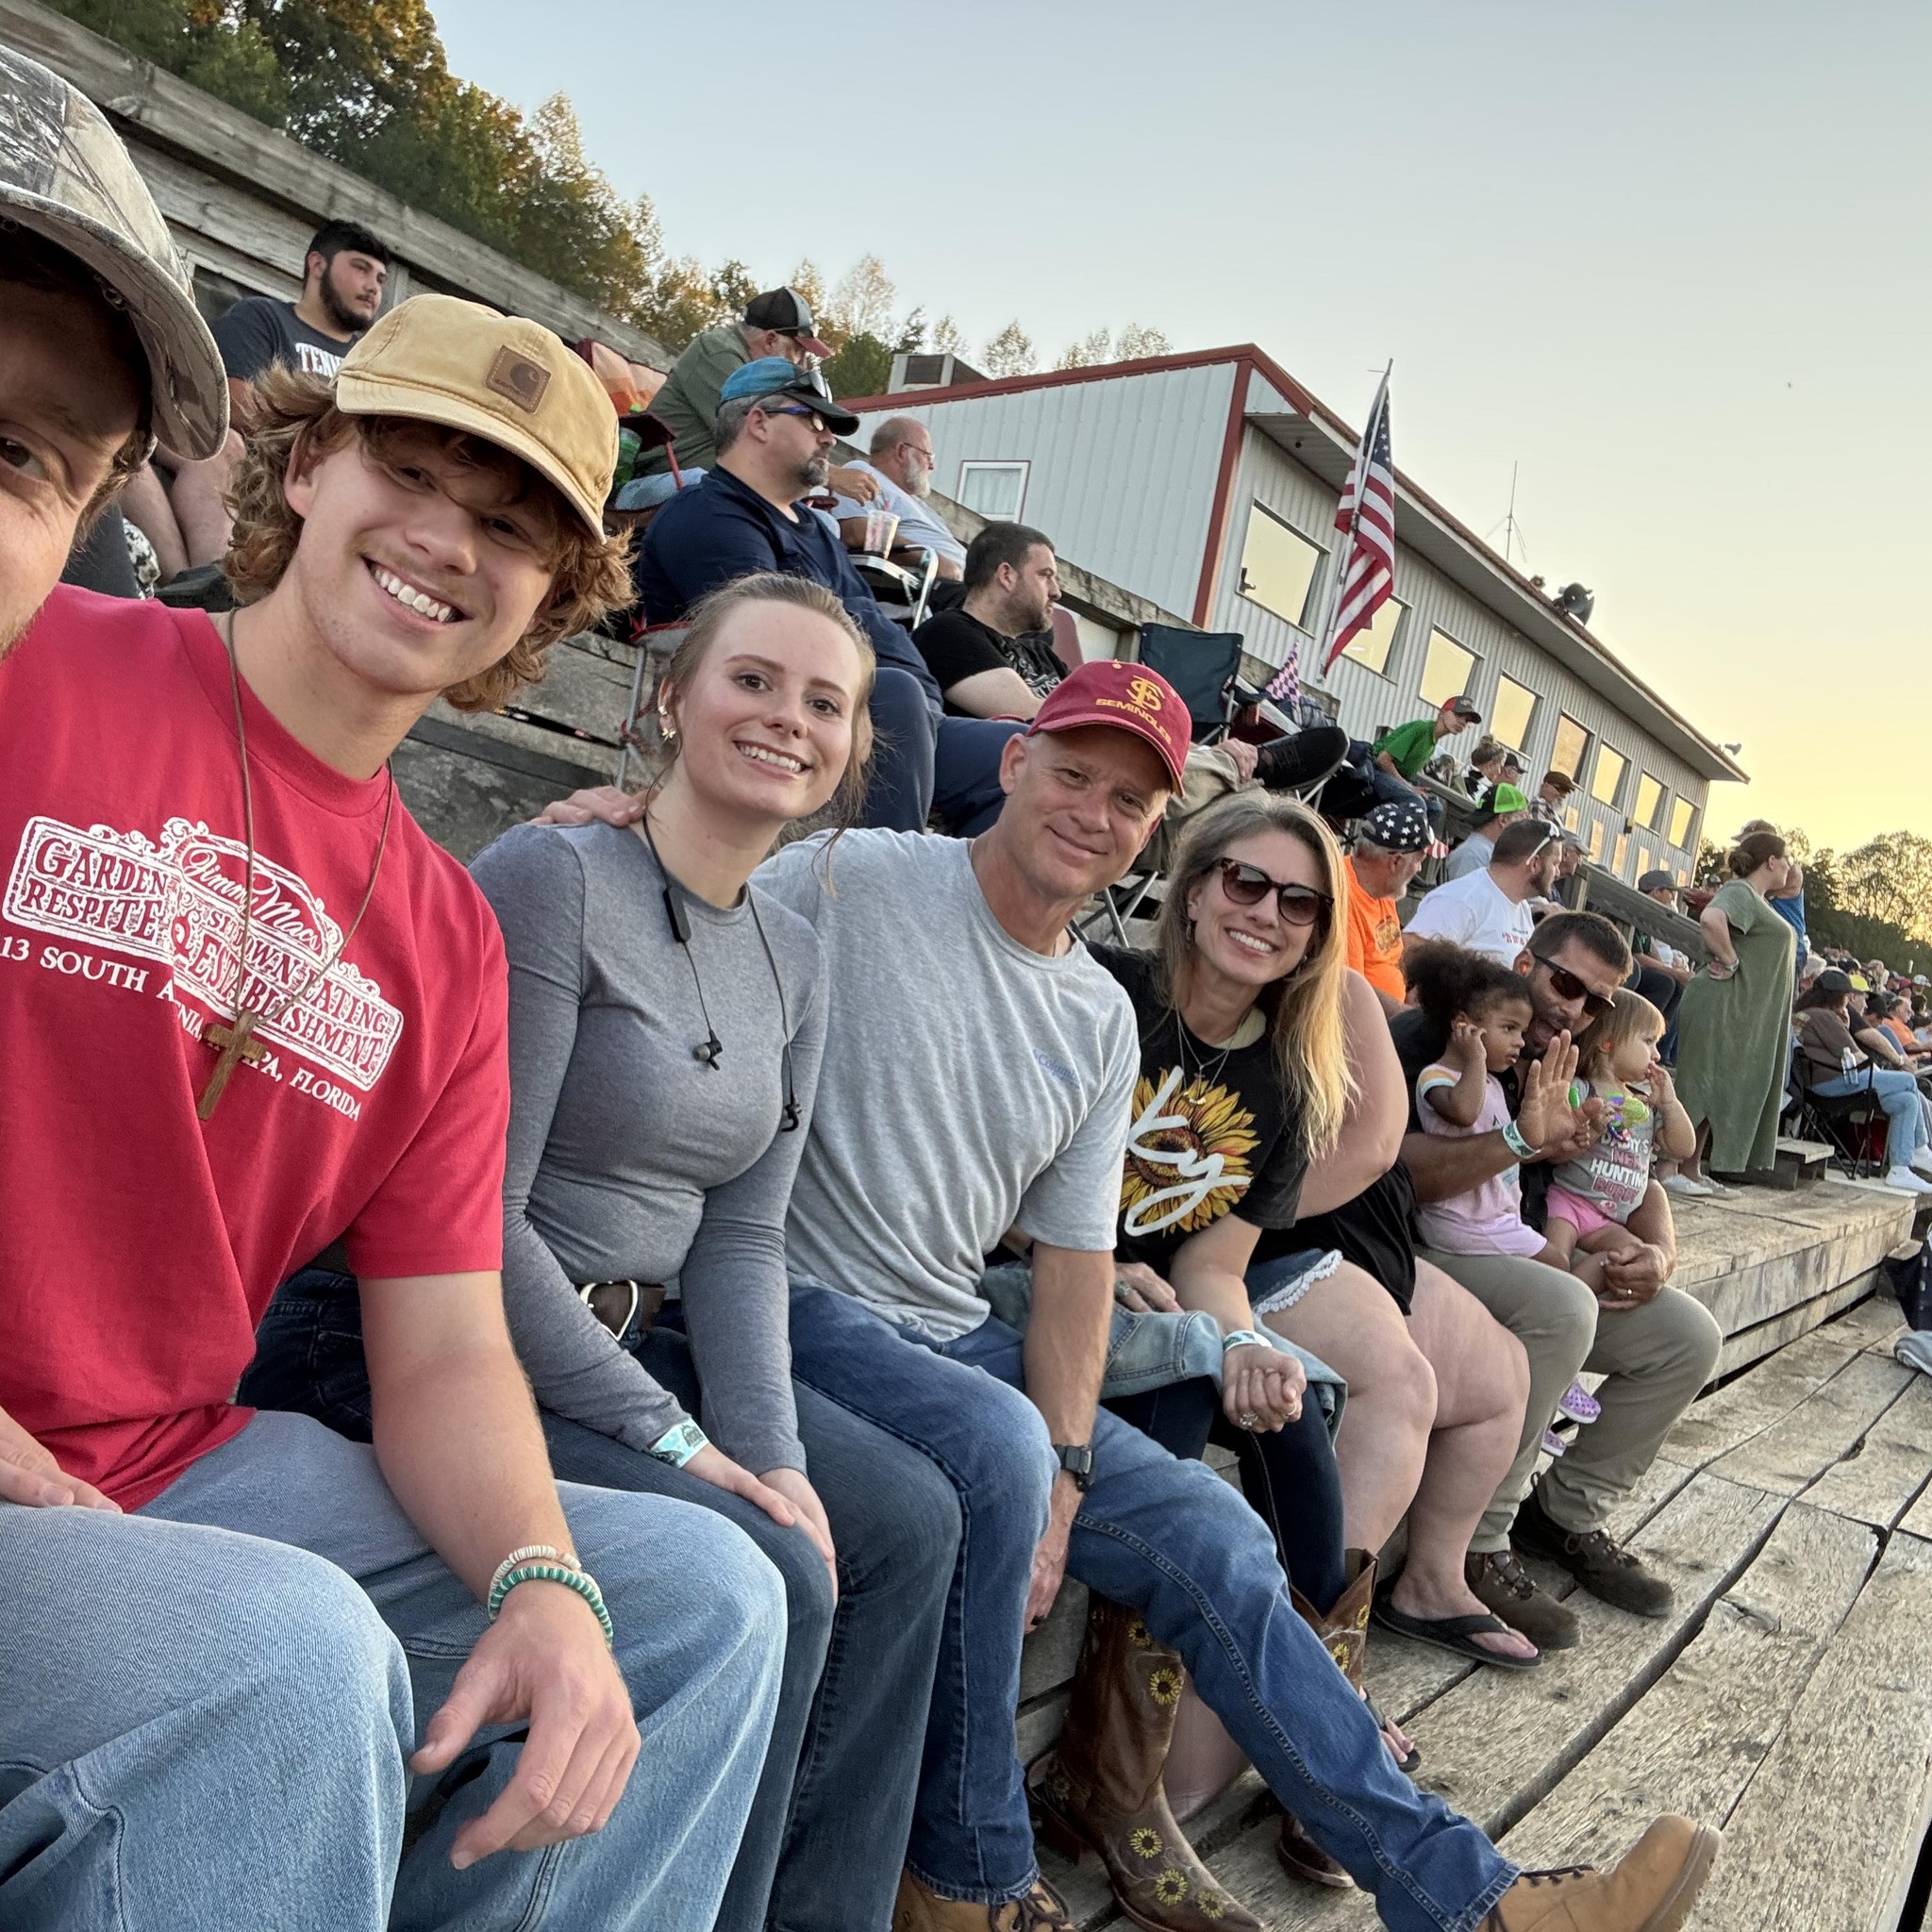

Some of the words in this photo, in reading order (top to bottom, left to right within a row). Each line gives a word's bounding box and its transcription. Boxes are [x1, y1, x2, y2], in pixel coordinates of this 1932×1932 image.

[34, 837, 169, 895] GARDEN
[183, 848, 258, 915] Jimmy
[21, 878, 166, 943] RESPITE
[188, 933, 384, 1074] ESTABLISHMENT
[301, 967, 388, 1034] EATING
[40, 946, 149, 993] SOUTH
[289, 1067, 362, 1123] FLORIDA
